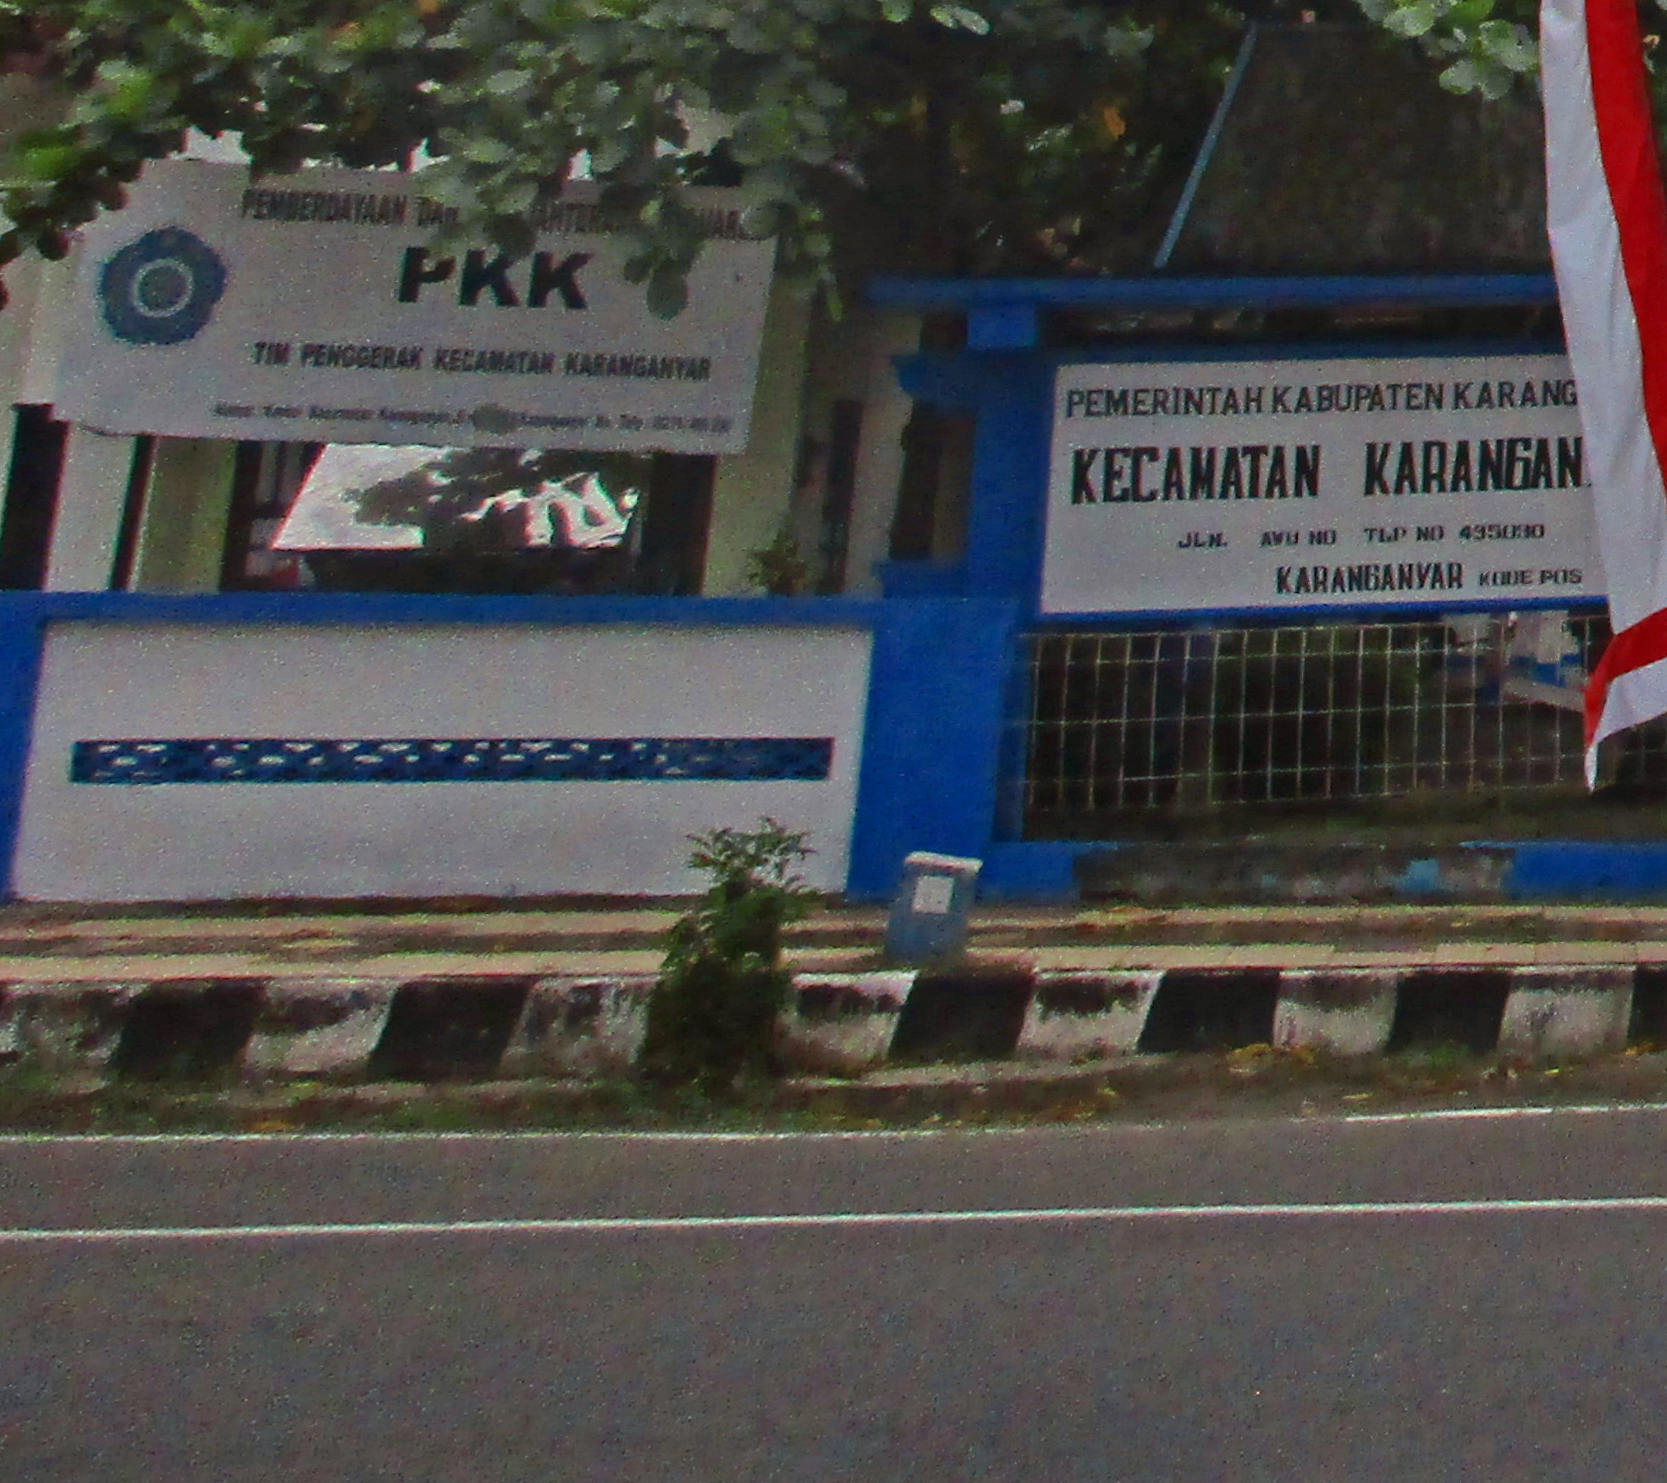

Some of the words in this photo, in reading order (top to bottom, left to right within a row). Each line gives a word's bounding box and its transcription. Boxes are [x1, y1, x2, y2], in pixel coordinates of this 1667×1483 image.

[241, 189, 407, 225] PEMBERDAYAAN
[399, 245, 594, 309] PKK
[252, 342, 290, 366] TIM
[301, 342, 423, 370] PENGGERAK
[434, 346, 555, 374] KECAMATAN
[563, 351, 712, 381] KARANGANYAR
[1066, 386, 1264, 417] PEMERINTAH
[1272, 382, 1444, 414] KABUPATEN
[1454, 378, 1578, 410] KARANG
[1072, 444, 1322, 505] KECAMATAN
[1364, 435, 1592, 497] KARANGAN
[1415, 525, 1445, 542] NO
[1276, 562, 1464, 595] KARANGANYAR
[1540, 568, 1584, 585] POS
